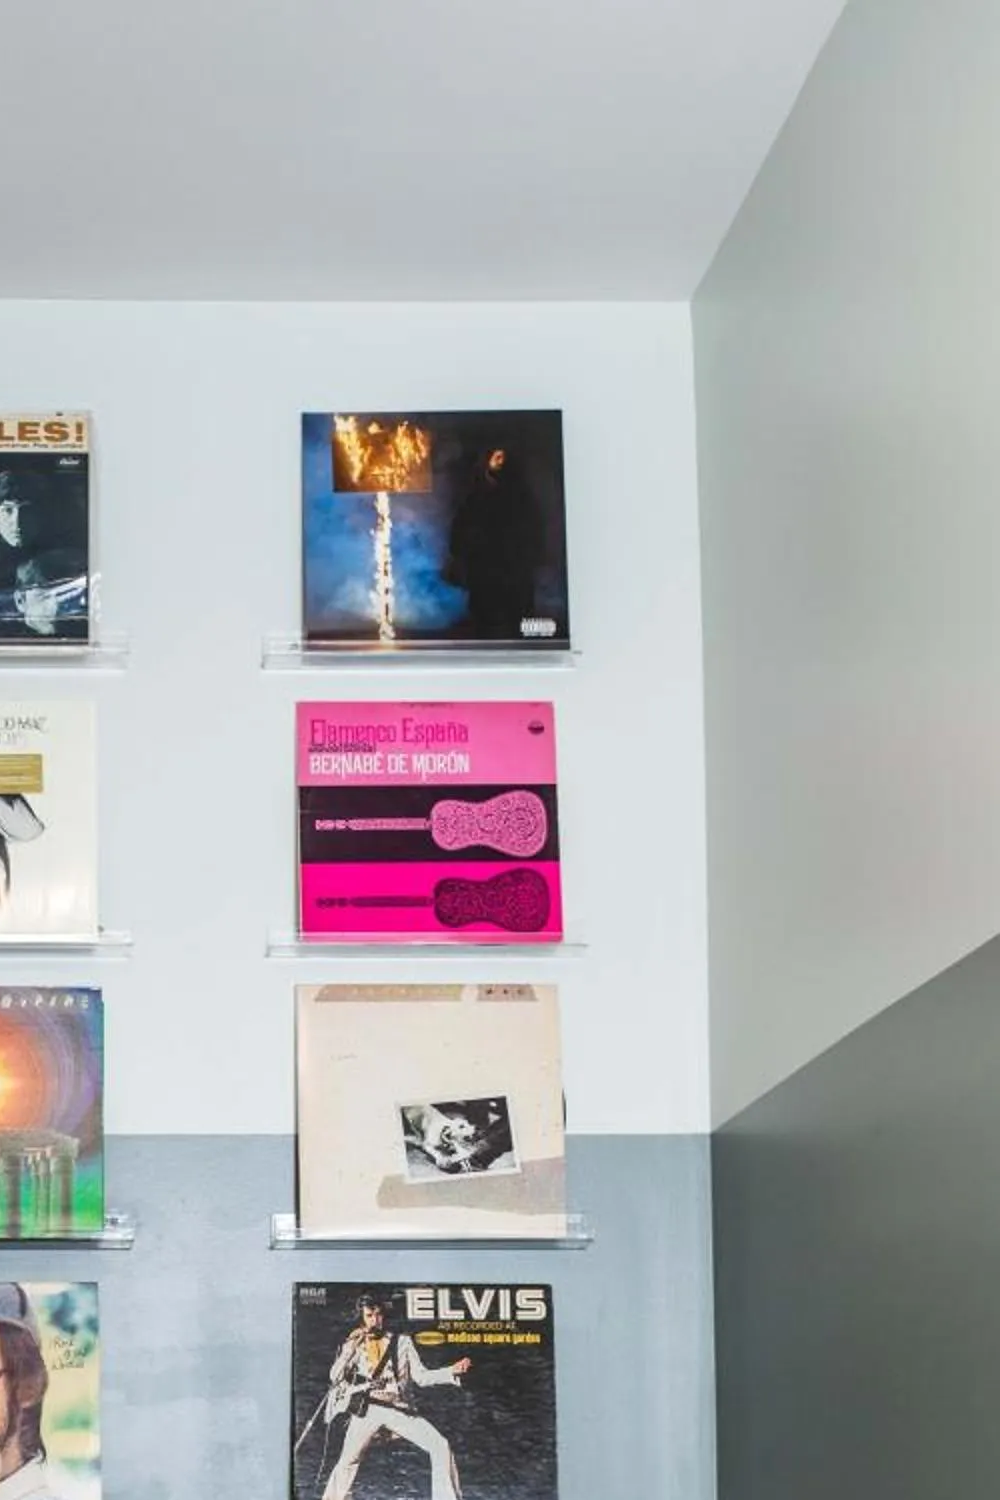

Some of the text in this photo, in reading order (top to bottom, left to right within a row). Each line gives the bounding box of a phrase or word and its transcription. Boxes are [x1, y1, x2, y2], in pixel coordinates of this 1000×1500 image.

[311, 717, 468, 752] Flamenco España
[387, 754, 408, 774] DE
[405, 1288, 547, 1320] ELVIS
